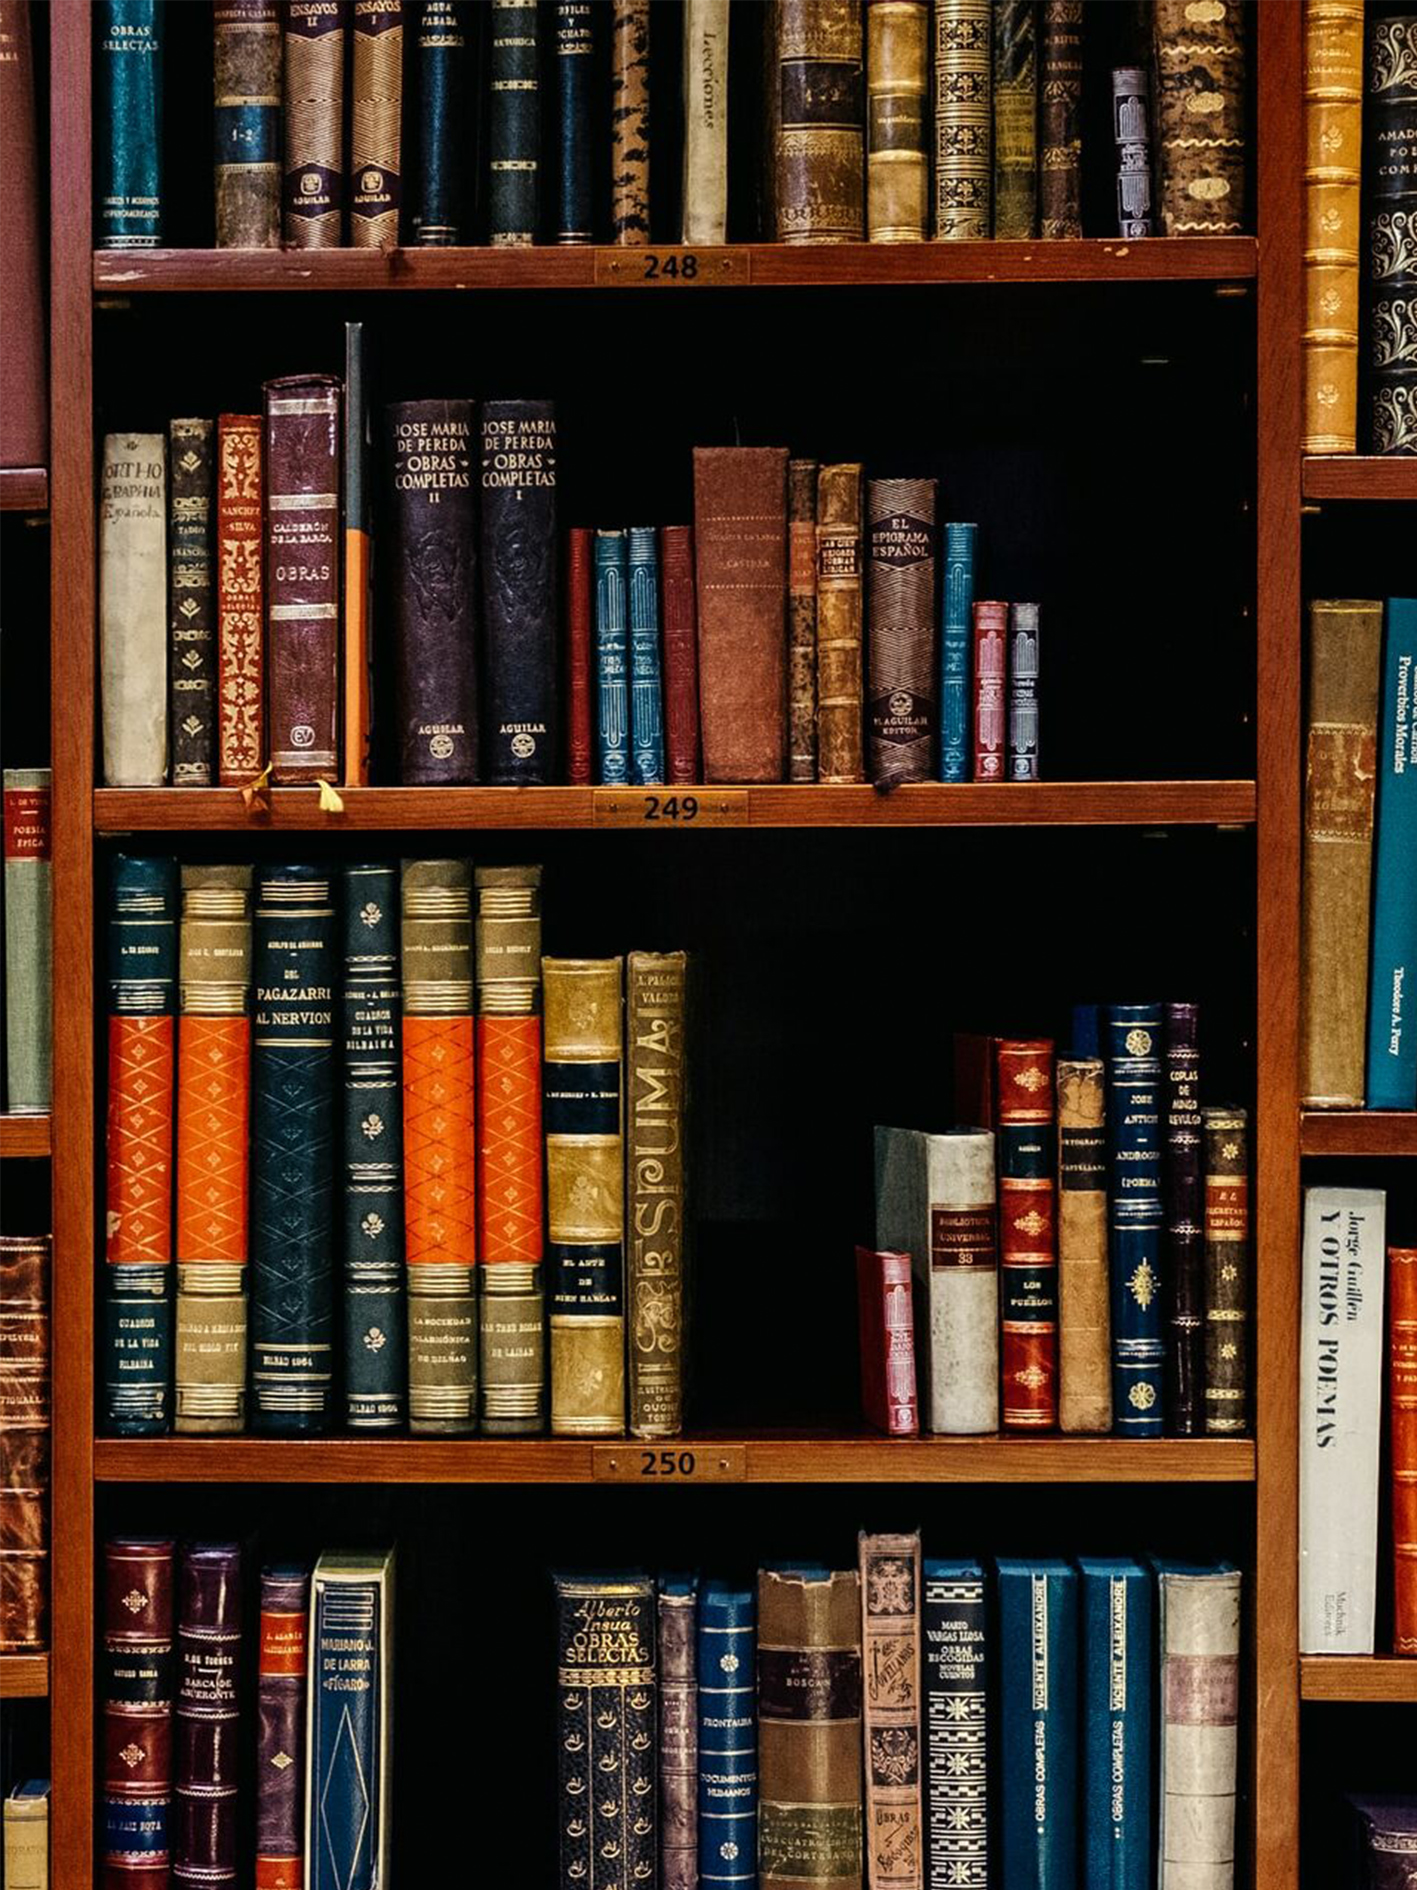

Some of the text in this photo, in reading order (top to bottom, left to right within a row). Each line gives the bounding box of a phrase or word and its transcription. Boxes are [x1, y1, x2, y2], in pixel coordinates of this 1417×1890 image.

[290, 3, 338, 16] ENSAYOS
[355, 1, 401, 15] ENSAYOS
[110, 25, 151, 37] OBRAS
[103, 40, 159, 51] SELECTAS
[644, 255, 697, 279] 248
[393, 423, 470, 437] JOSE MARIA
[481, 421, 557, 435] JOSE MARIA
[398, 438, 467, 452] DE PEREDA
[485, 436, 554, 450] DE PEREDA
[407, 455, 456, 472] OBRAS
[494, 454, 543, 470] OBRAS
[105, 463, 163, 480] ORTHO
[395, 472, 470, 490] COMPLETAS
[482, 471, 557, 488] COMPLETAS
[429, 492, 440, 503] II
[892, 519, 910, 529] EL
[873, 533, 930, 543] EPIGRAMA
[873, 543, 929, 557] ESPAÑOL
[276, 566, 330, 581] OBRAS
[1394, 656, 1412, 773] Proverbios Morales
[417, 724, 465, 735] AGUILAR
[499, 723, 547, 734] AGUILAR
[644, 797, 698, 820] 249
[257, 987, 332, 1001] PAGAZARRI
[256, 1012, 332, 1025] AL NERVION
[1170, 1070, 1199, 1082] COPLAS
[1178, 1084, 1190, 1096] DE
[1345, 1211, 1366, 1256] Jorge
[957, 1252, 974, 1265] 33
[1315, 1211, 1341, 1448] Y OTROS POEMAS
[641, 1452, 695, 1475] 250
[574, 1600, 642, 1617] Alberto
[941, 1621, 969, 1630] MARIO
[321, 1639, 363, 1651] MARIANO
[573, 1632, 640, 1648] OBRAS
[565, 1647, 650, 1663] SELECTAS
[928, 1653, 985, 1662] ESCOGIDAS
[940, 1645, 973, 1656] OBRAS
[323, 1659, 371, 1671] DE LARRA
[1034, 1581, 1046, 1822] OBRAS COMPLETAS VICENTE ALEIXANDRE
[1112, 1581, 1125, 1822] OBRAS COMPLETAS VICENTE ALEIXANDRE
